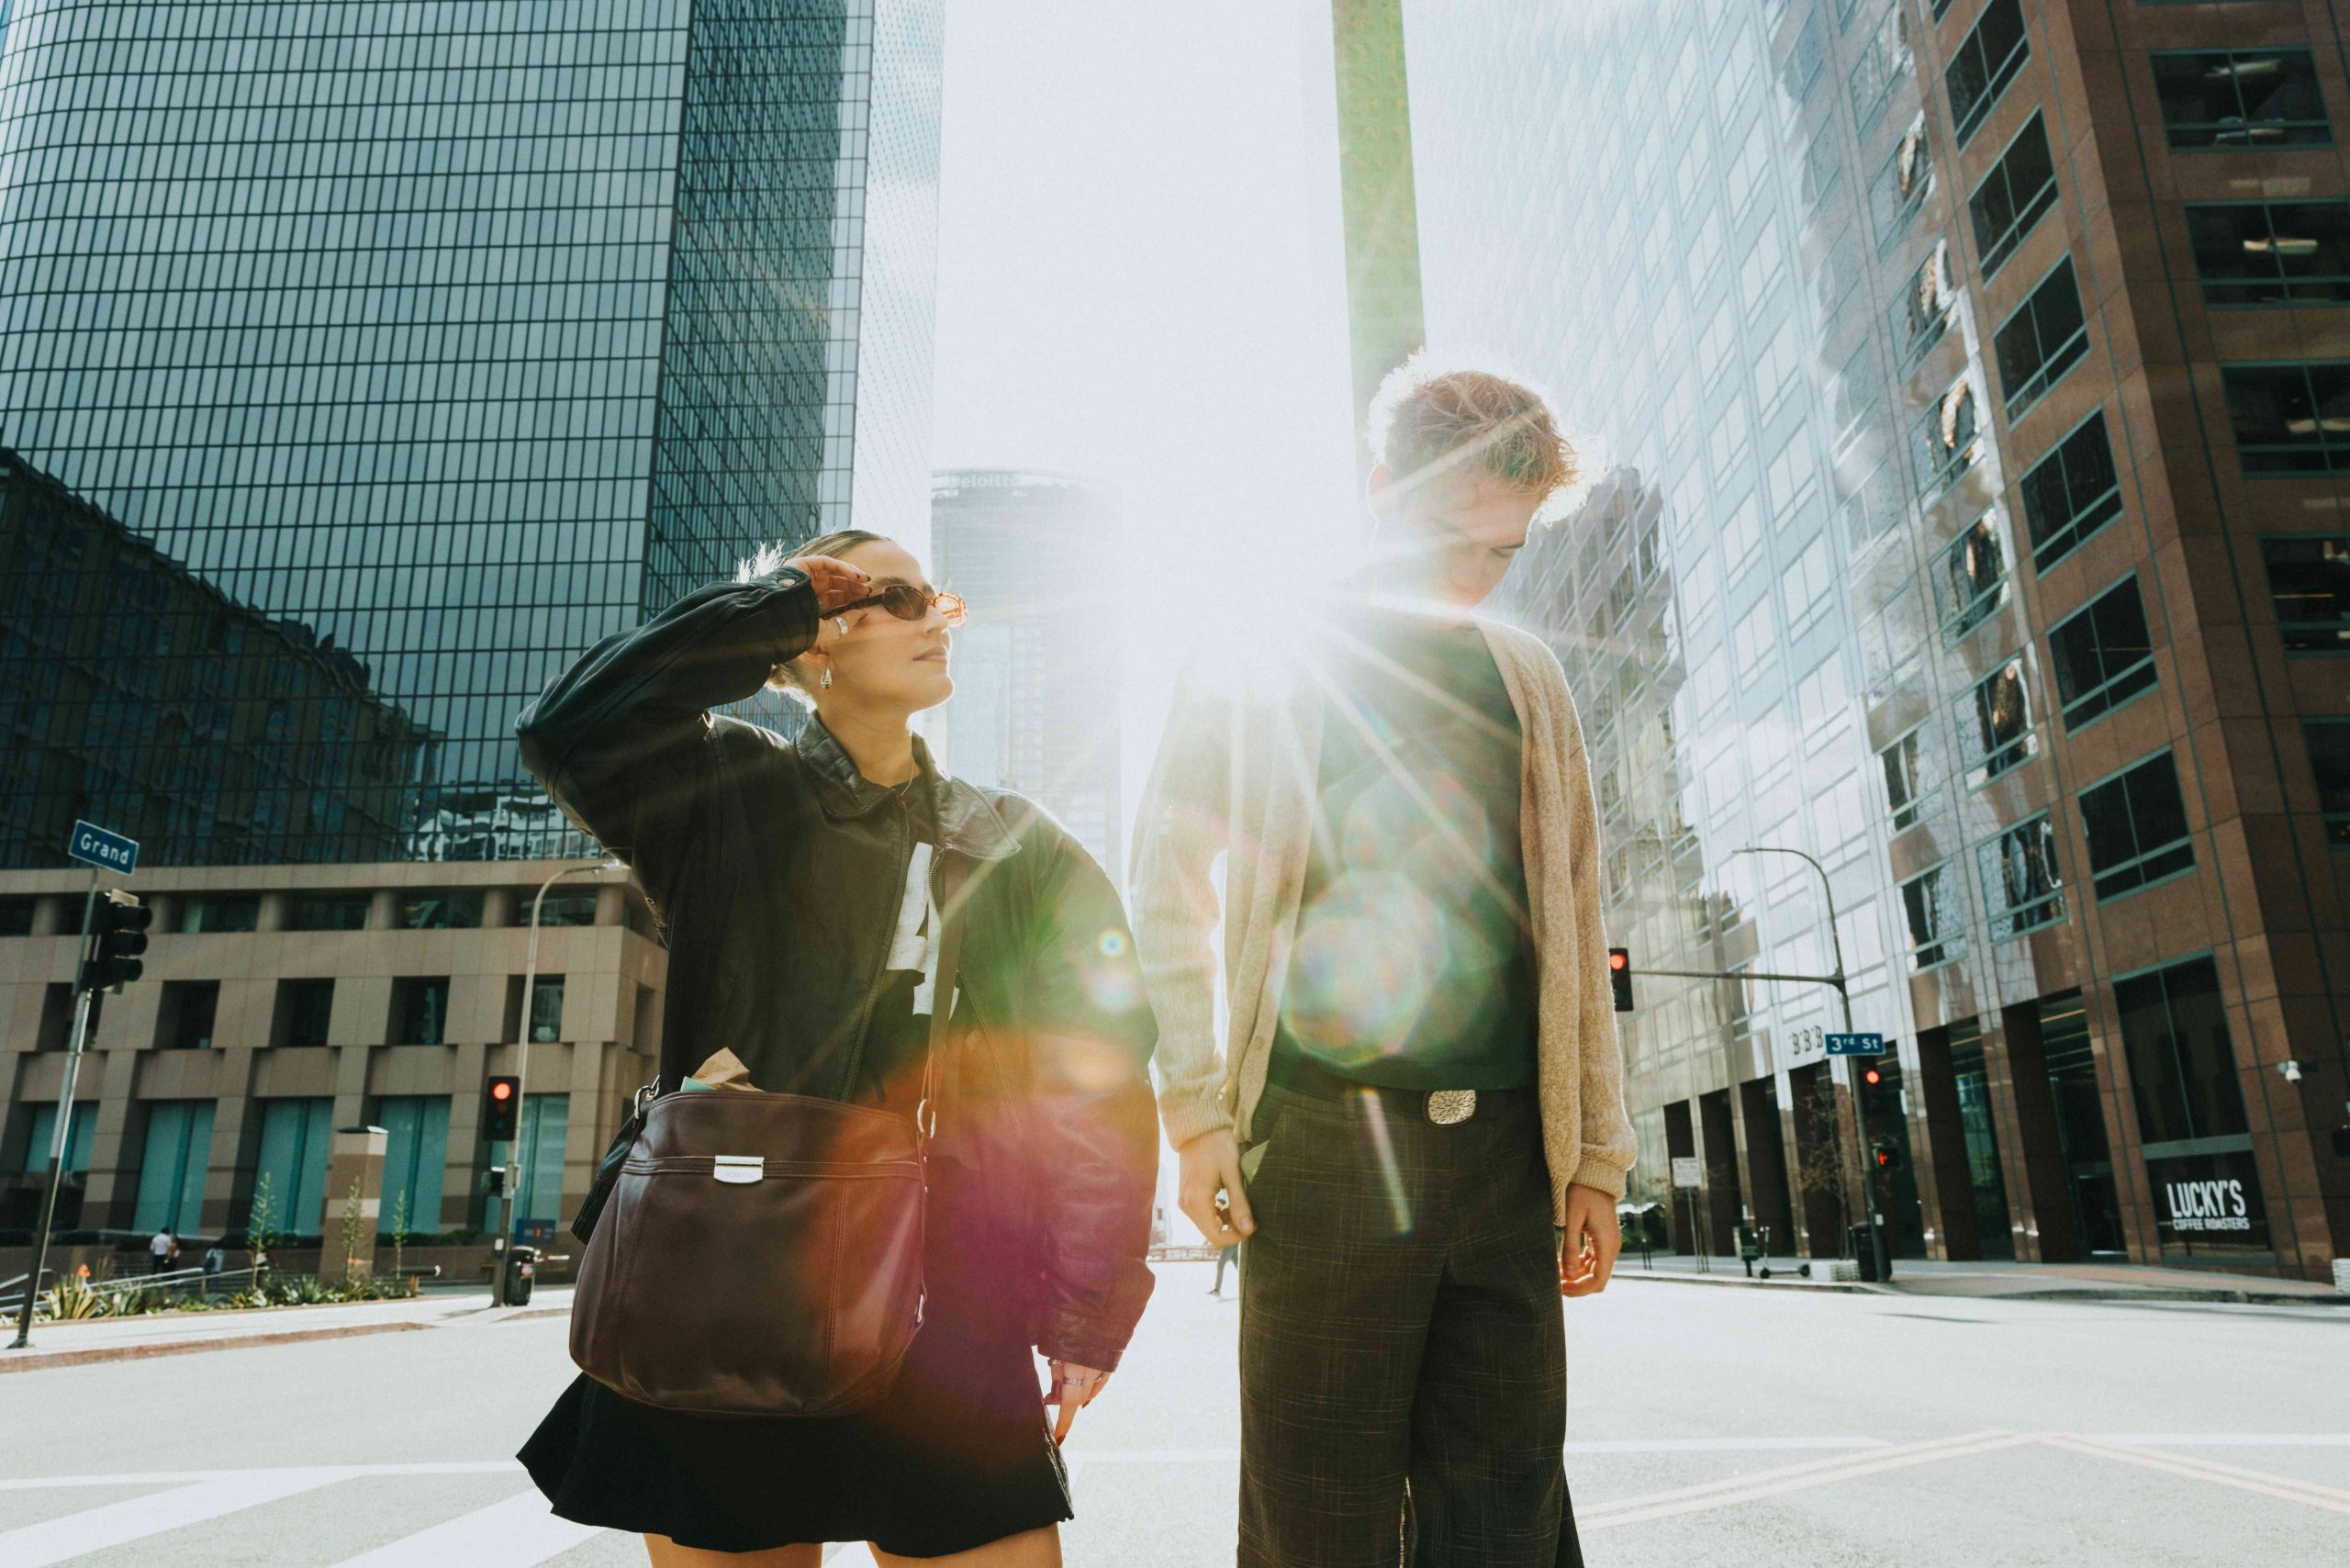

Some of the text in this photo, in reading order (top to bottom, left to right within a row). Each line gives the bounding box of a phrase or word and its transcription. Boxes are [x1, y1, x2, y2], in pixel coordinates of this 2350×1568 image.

[81, 833, 130, 865] Grand
[1830, 1037, 1879, 1051] 3rd St
[2166, 1179, 2246, 1218] LUCKY'S
[2173, 1216, 2251, 1231] COFFEE ROASTERS
